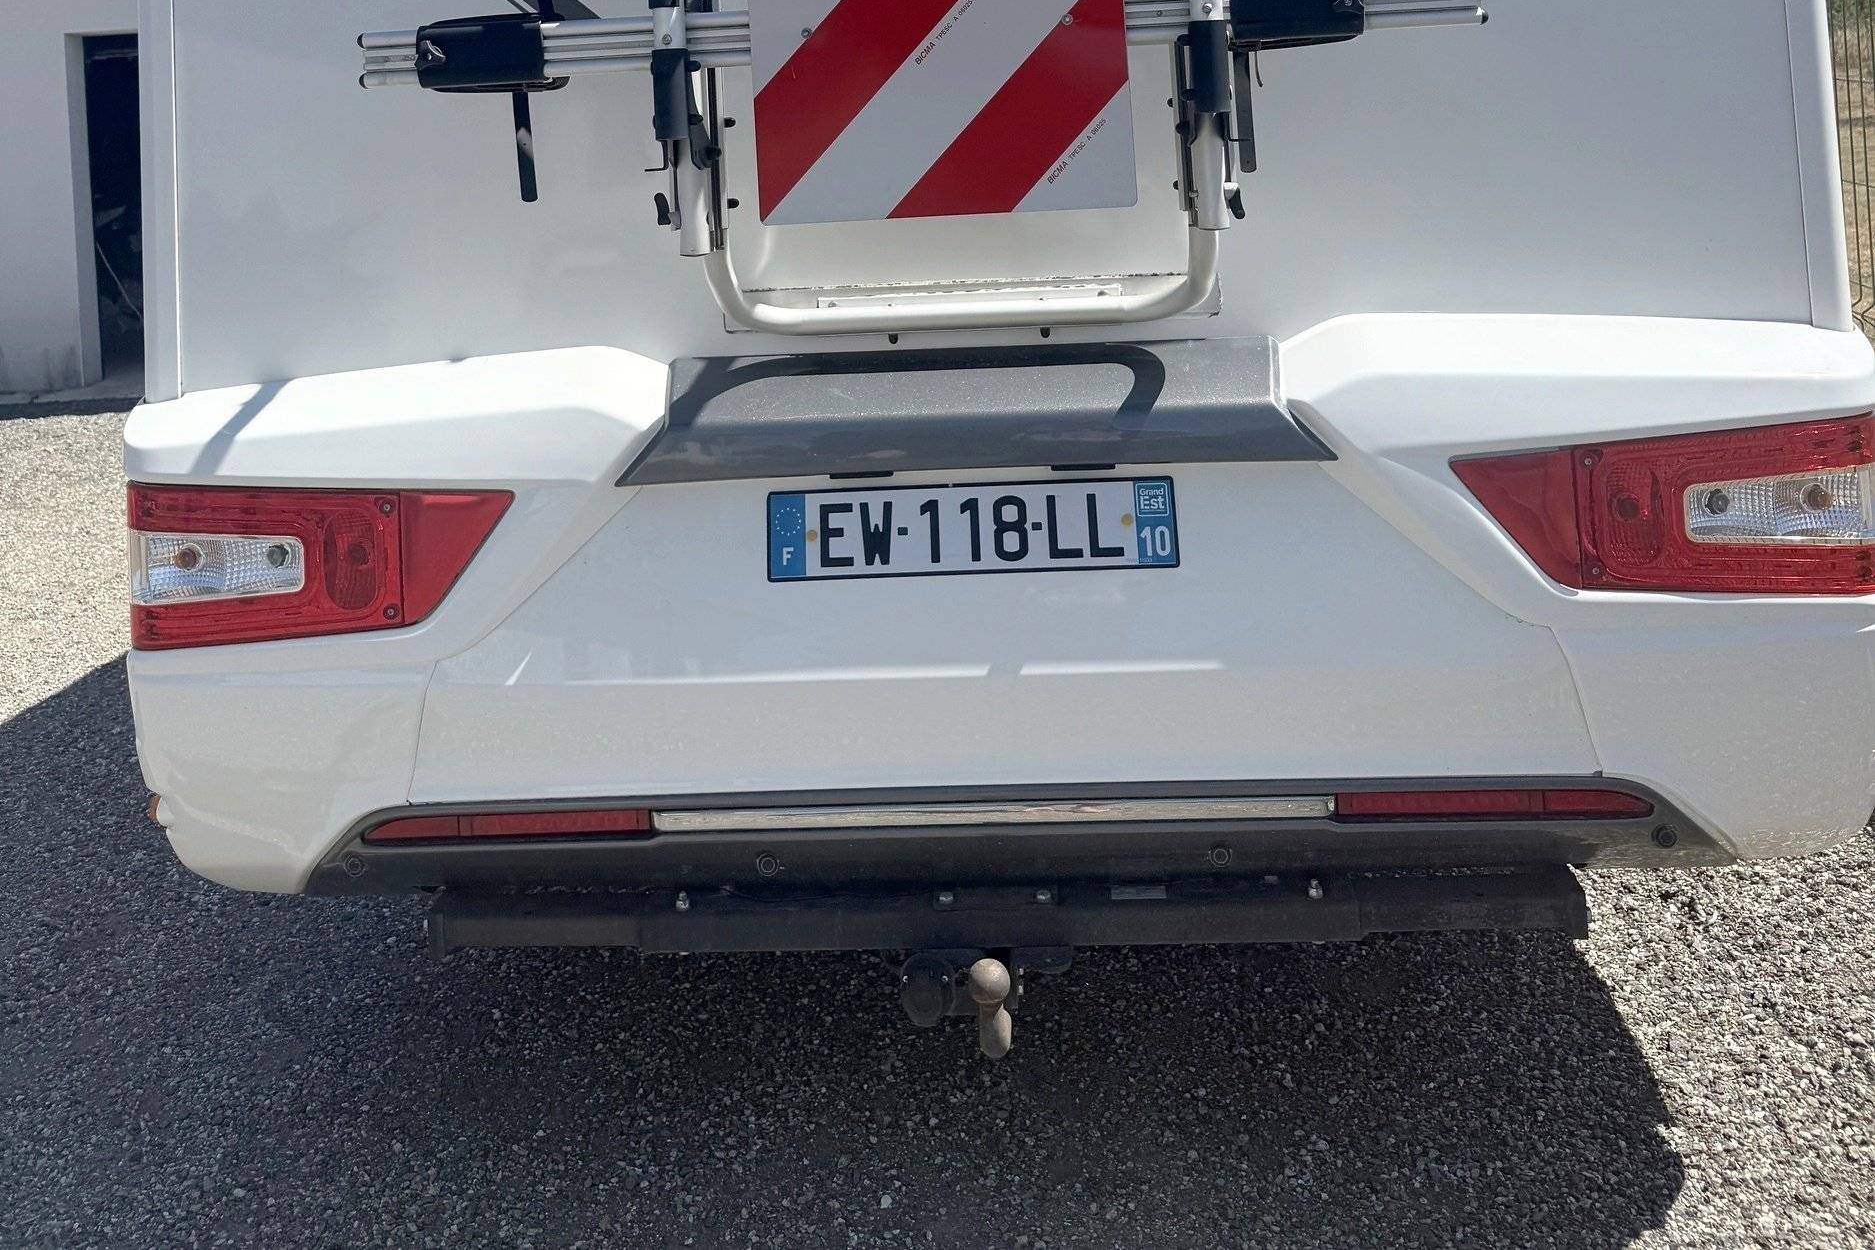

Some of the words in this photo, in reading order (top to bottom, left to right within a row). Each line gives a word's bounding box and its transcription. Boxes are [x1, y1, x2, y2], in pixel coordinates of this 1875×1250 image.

[914, 41, 936, 65] BICMA
[1046, 160, 1069, 185] BICMA
[1139, 487, 1164, 496] Grand
[1140, 495, 1165, 510] Est
[819, 493, 1125, 568] EW-118-LL
[1140, 525, 1171, 557] 10
[782, 546, 795, 566] F
